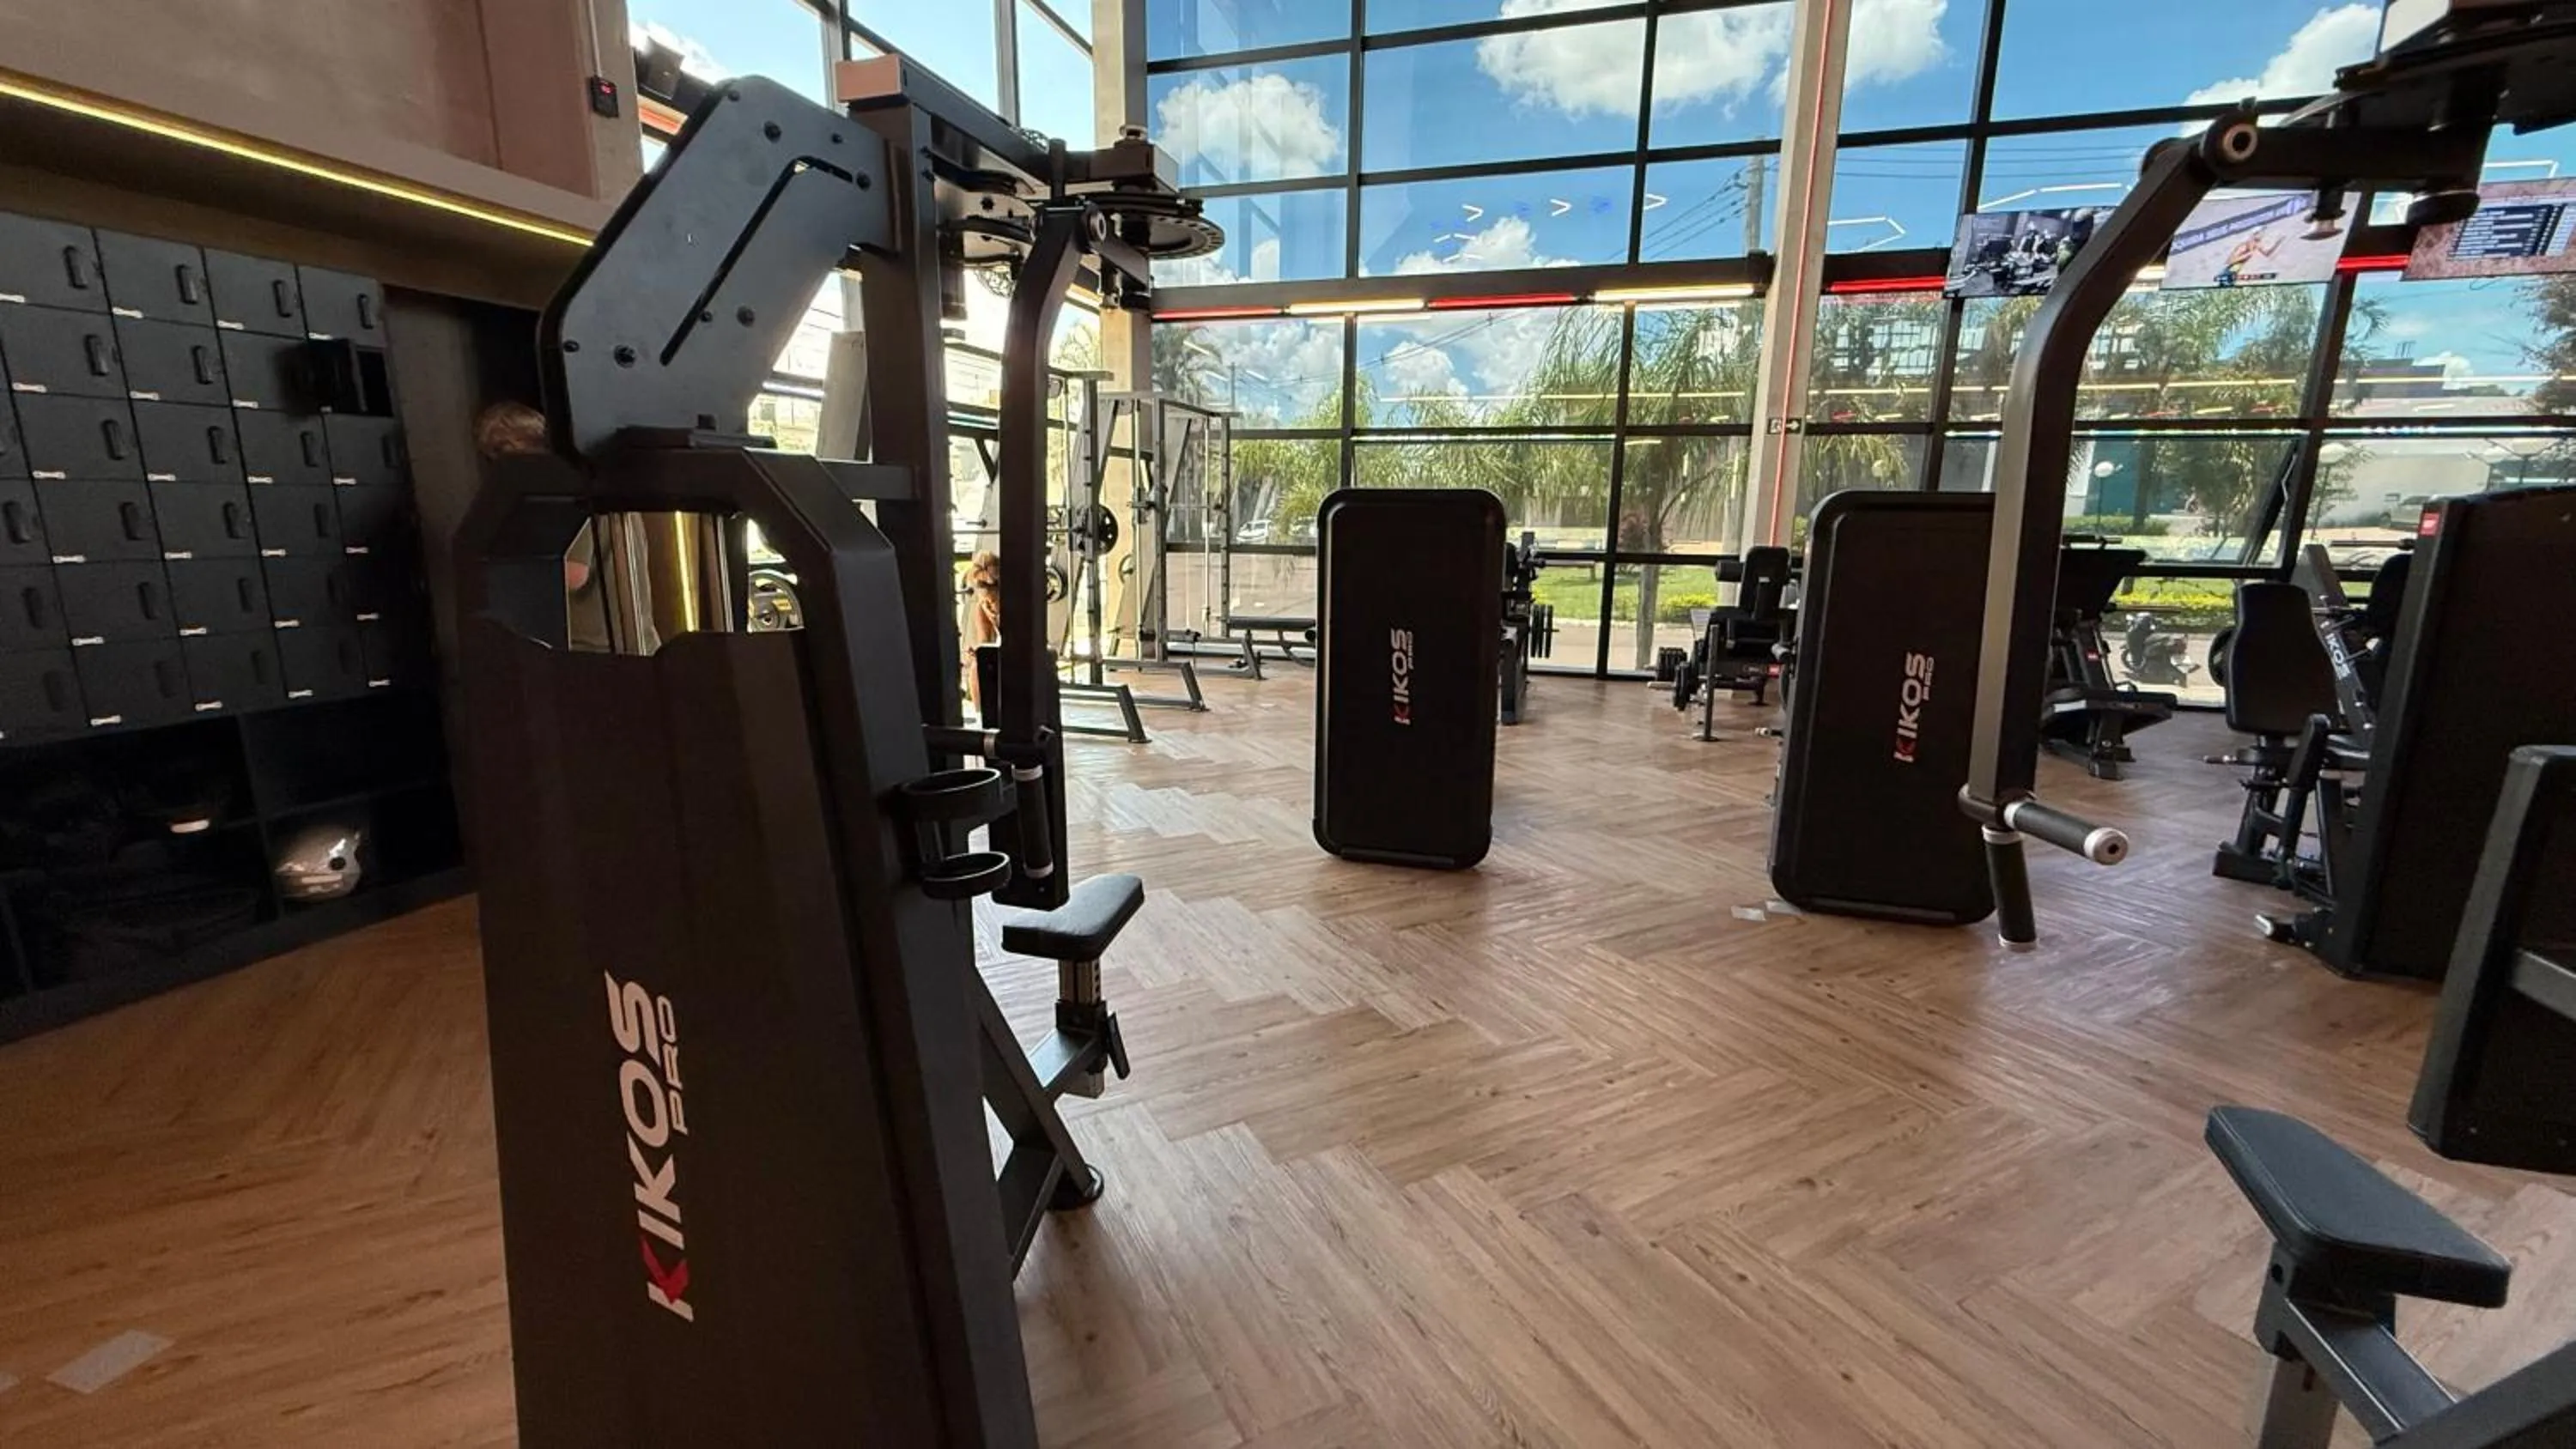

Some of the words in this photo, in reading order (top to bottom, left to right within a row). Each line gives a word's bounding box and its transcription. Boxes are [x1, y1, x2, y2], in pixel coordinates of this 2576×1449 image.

[1390, 627, 1412, 725] KIKOS
[1893, 651, 1926, 763] KIKOS
[656, 994, 689, 1136] PRO
[604, 969, 695, 1323] KIKOS
